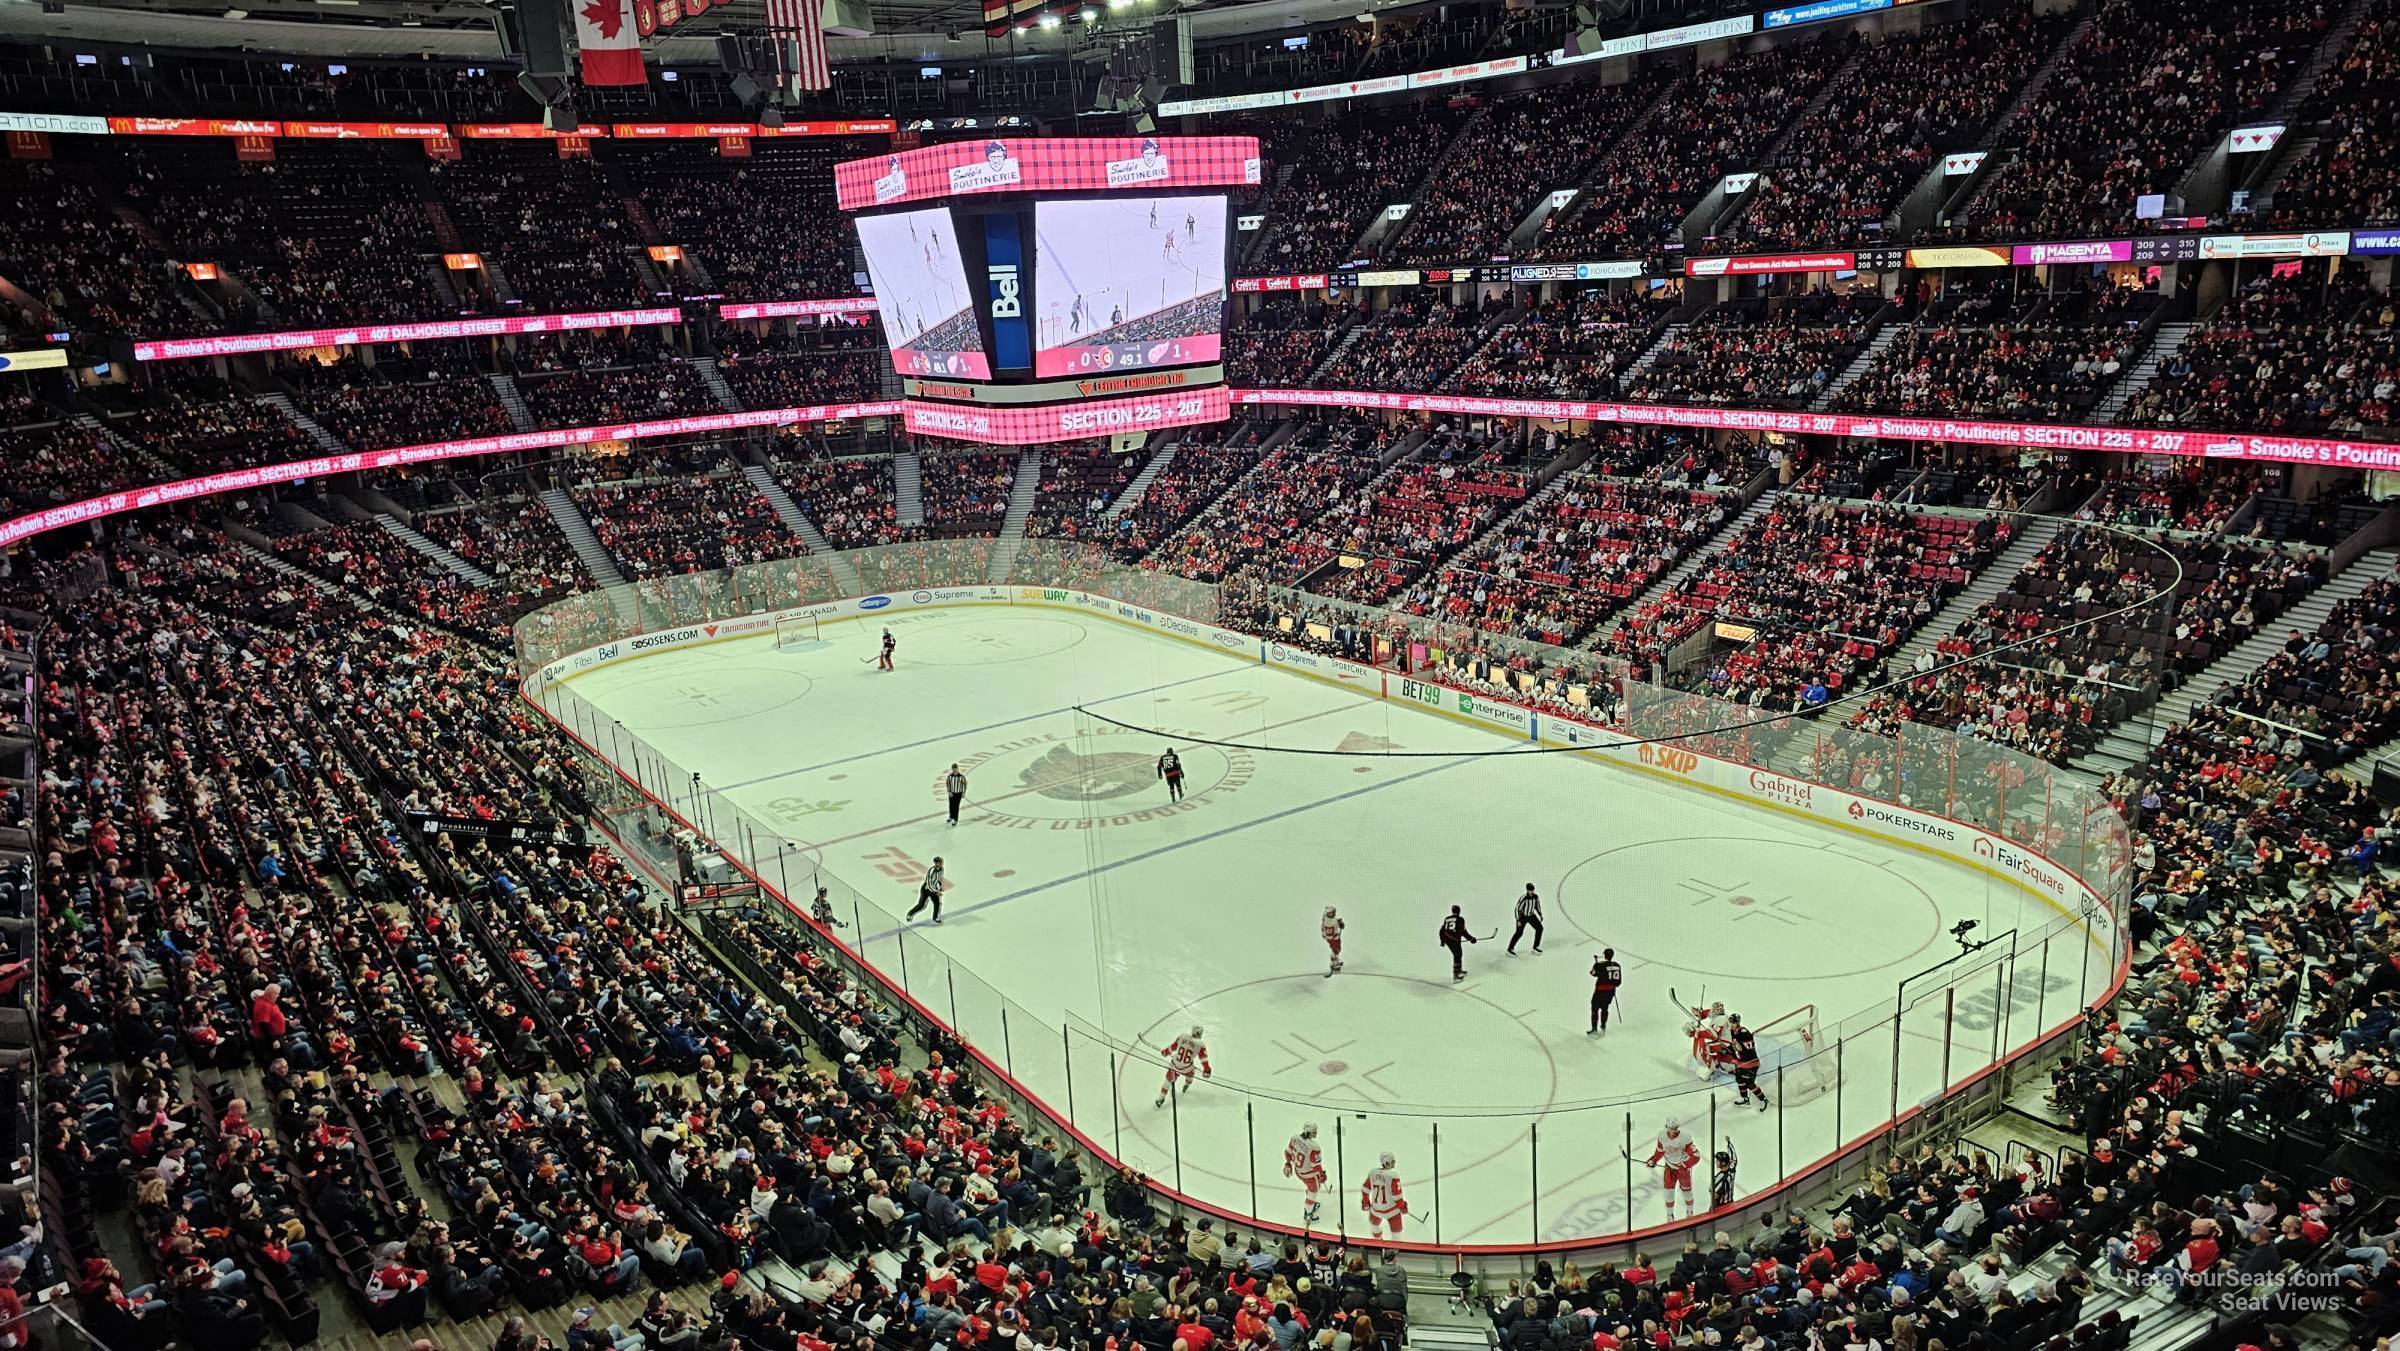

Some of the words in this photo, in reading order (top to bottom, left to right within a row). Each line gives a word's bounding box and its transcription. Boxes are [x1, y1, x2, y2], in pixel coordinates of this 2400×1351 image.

[1708, 20, 1752, 36] LÉPINE
[1607, 38, 1645, 53] LÉPINE
[1489, 58, 1517, 70] Hyperline
[1303, 88, 1329, 98] CANADIAN
[1330, 87, 1341, 96] TIRE
[1360, 82, 1385, 92] CANADIAN
[1386, 80, 1400, 89] TIRE
[953, 166, 982, 181] Smoke's
[1110, 162, 1138, 175] Smoke's
[1111, 168, 1167, 184] POUTINERIE
[953, 172, 1018, 191] POUTINERIE
[2047, 242, 2112, 256] MAGENTA
[2136, 240, 2155, 249] 309
[2178, 239, 2195, 248] 310
[1858, 252, 1871, 260] 308
[1887, 251, 1901, 259] 309
[2136, 250, 2154, 260] 209
[2177, 250, 2194, 259] 210
[1590, 267, 1615, 275] KONICA
[1733, 262, 1748, 270] Know
[1782, 260, 1800, 268] Faster.
[1801, 259, 1825, 267] Remove
[1826, 258, 1846, 266] Waste.
[1858, 261, 1871, 269] 208
[1887, 260, 1901, 268] 209
[1298, 275, 1323, 286] Gabriel
[1429, 270, 1450, 279] ROSS
[1512, 267, 1549, 280] ALIGNED
[1235, 278, 1259, 288] Gabriel
[1266, 277, 1291, 287] Gabriel
[988, 265, 1021, 318] Bell
[766, 303, 806, 316] Smoke's
[808, 300, 856, 313] Poutinerie
[563, 314, 596, 328] Down
[611, 312, 632, 325] The
[635, 310, 674, 323] Market
[370, 329, 389, 340] 407
[393, 324, 460, 340] DALHOUSIE
[462, 321, 506, 334] STREET
[164, 342, 212, 357] Smoke's
[215, 337, 270, 352] Poutinerie
[274, 334, 314, 348] Ottawa
[1173, 344, 1182, 358] 1
[912, 356, 920, 369] 0
[1081, 352, 1090, 366] 0
[1120, 353, 1142, 366] 49.1
[1261, 391, 1293, 402] Smoke's
[1296, 392, 1332, 403] Poutinerie
[1332, 392, 1366, 404] SECTION
[1366, 395, 1380, 406] 225
[858, 404, 900, 416] Smoke's
[1424, 398, 1458, 410] Smoke's
[1460, 399, 1500, 412] Poutinerie
[1502, 401, 1542, 414] SECTION
[1543, 403, 1560, 416] 225
[1570, 405, 1587, 416] 207
[636, 424, 678, 437] Smoke's
[682, 418, 730, 431] Poutinerie
[733, 412, 778, 426] SECTION
[780, 411, 798, 421] 225
[808, 408, 825, 418] 207
[914, 409, 950, 430] SECTION
[951, 414, 966, 431] 225
[974, 417, 988, 433] 207
[1060, 408, 1132, 431] SECTION
[1135, 405, 1162, 423] 225
[1178, 400, 1203, 418] 207
[1620, 407, 1664, 422] Smoke's
[1666, 410, 1720, 425] Poutinerie
[1722, 412, 1776, 427] SECTION
[1778, 416, 1799, 428] 225
[1813, 418, 1835, 430] 207
[1881, 420, 1940, 437] Smoke's
[1944, 424, 2020, 441] Poutinerie
[2023, 428, 2098, 446] SECTION
[2102, 431, 2132, 447] 225
[2152, 434, 2184, 451] 207
[401, 448, 443, 461] Smoke's
[445, 441, 497, 455] Poutinerie
[500, 435, 546, 449] SECTION
[548, 434, 566, 444] 225
[576, 431, 594, 441] 207
[2248, 438, 2331, 460] Smoke's
[2336, 444, 2400, 466] Poutin
[160, 481, 204, 500] Smoke's
[204, 472, 258, 492] Poutinerie
[260, 463, 309, 482] SECTION
[311, 460, 331, 473] 225
[341, 456, 361, 468] 207
[2264, 468, 2281, 476] 108
[10, 518, 44, 534] Poutinerie
[45, 506, 86, 525] SECTION
[86, 503, 102, 517] 225
[110, 496, 126, 510] 207
[934, 591, 974, 600] Supreme
[1020, 588, 1069, 602] SUBWAY
[804, 606, 838, 617] CANADA
[721, 621, 750, 634] CANADIAN
[750, 619, 770, 631] TIRE
[1167, 618, 1198, 636] Decisive
[632, 629, 699, 650] 5050SENS.COM
[599, 646, 618, 661] Bell
[1287, 650, 1317, 667] Supreme
[574, 656, 592, 669] Fibe
[1402, 679, 1441, 706] BET99
[1462, 700, 1524, 723] enterprise
[1656, 747, 1698, 775] SKIP
[1750, 771, 1812, 800] Gabriel
[1768, 791, 1813, 809] PIZZA
[439, 822, 489, 832] brookstreet
[1866, 808, 1955, 842] POKERSTARS
[1998, 848, 2064, 895] FairSquare
[1176, 1046, 1192, 1065] 96
[1374, 1184, 1388, 1204] 71
